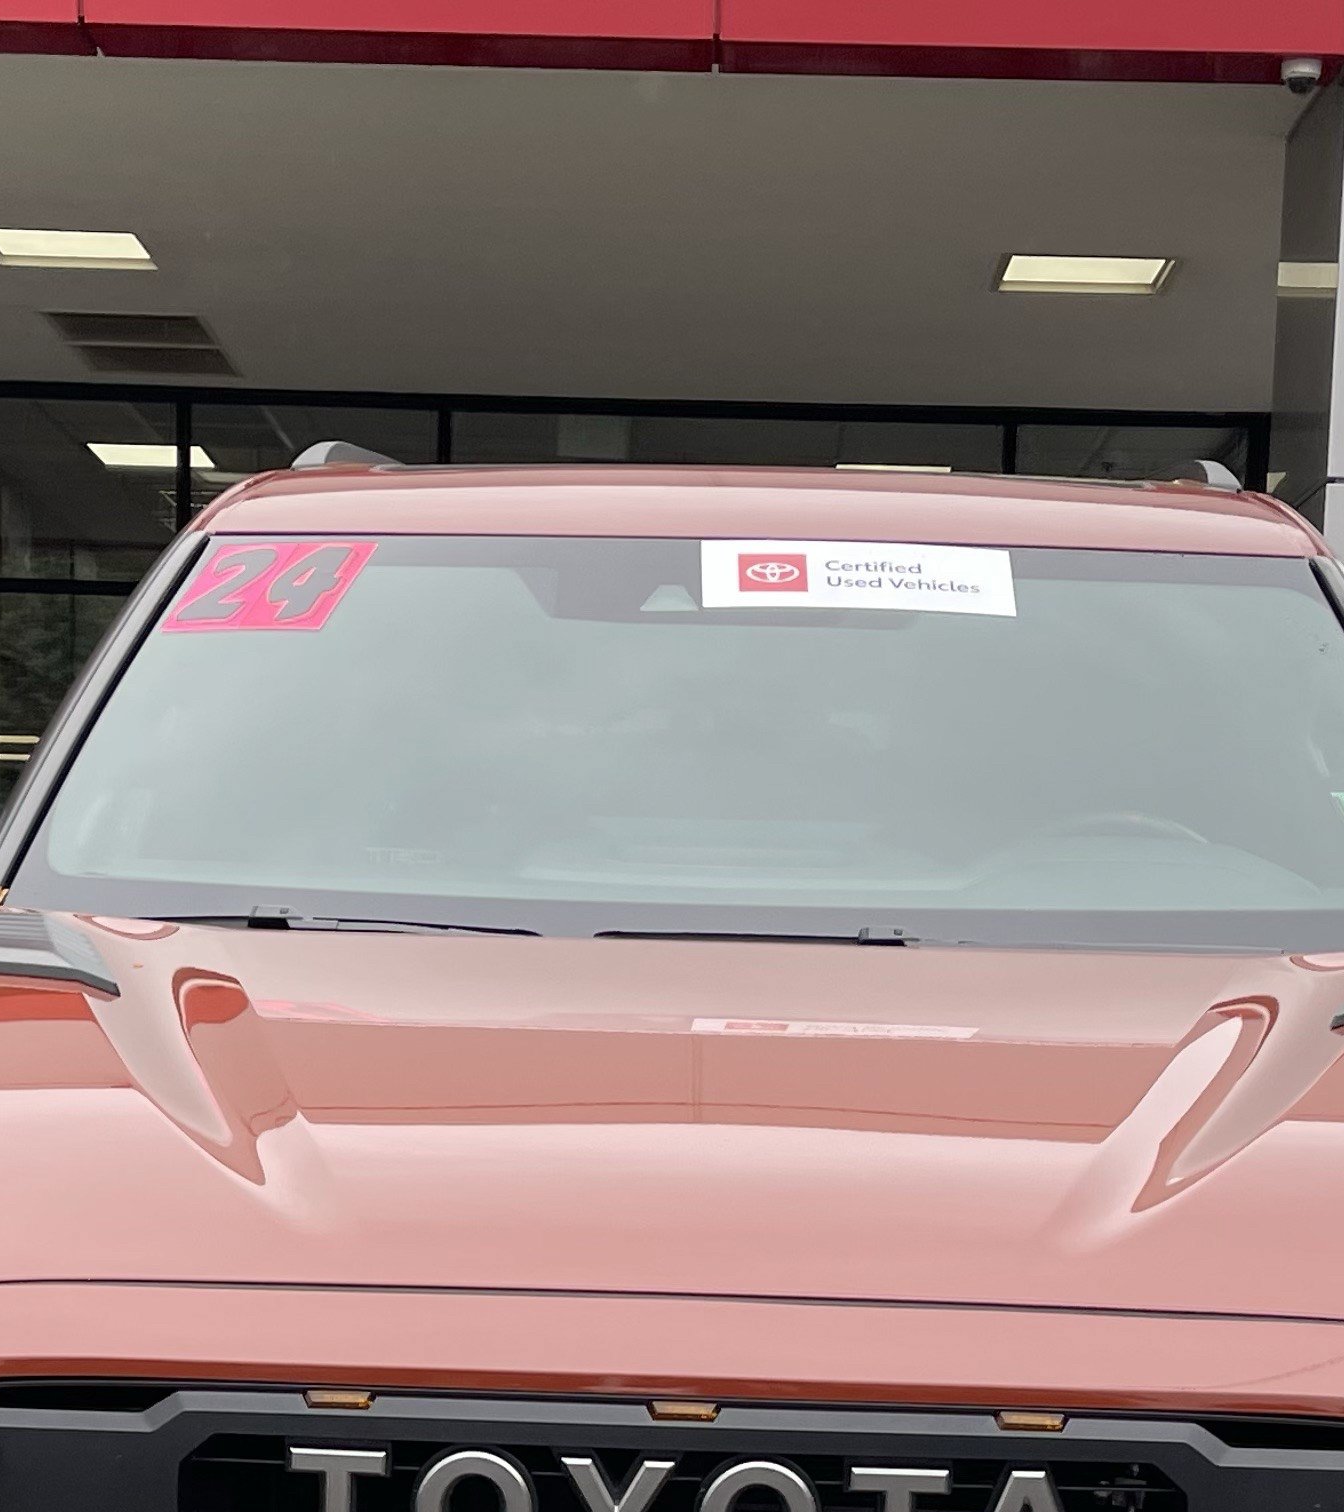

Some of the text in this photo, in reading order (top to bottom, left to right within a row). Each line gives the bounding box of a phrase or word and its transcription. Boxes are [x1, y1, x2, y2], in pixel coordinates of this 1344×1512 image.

[825, 560, 922, 574] Certified
[176, 545, 355, 622] 24
[826, 575, 981, 594] Used Vehicles
